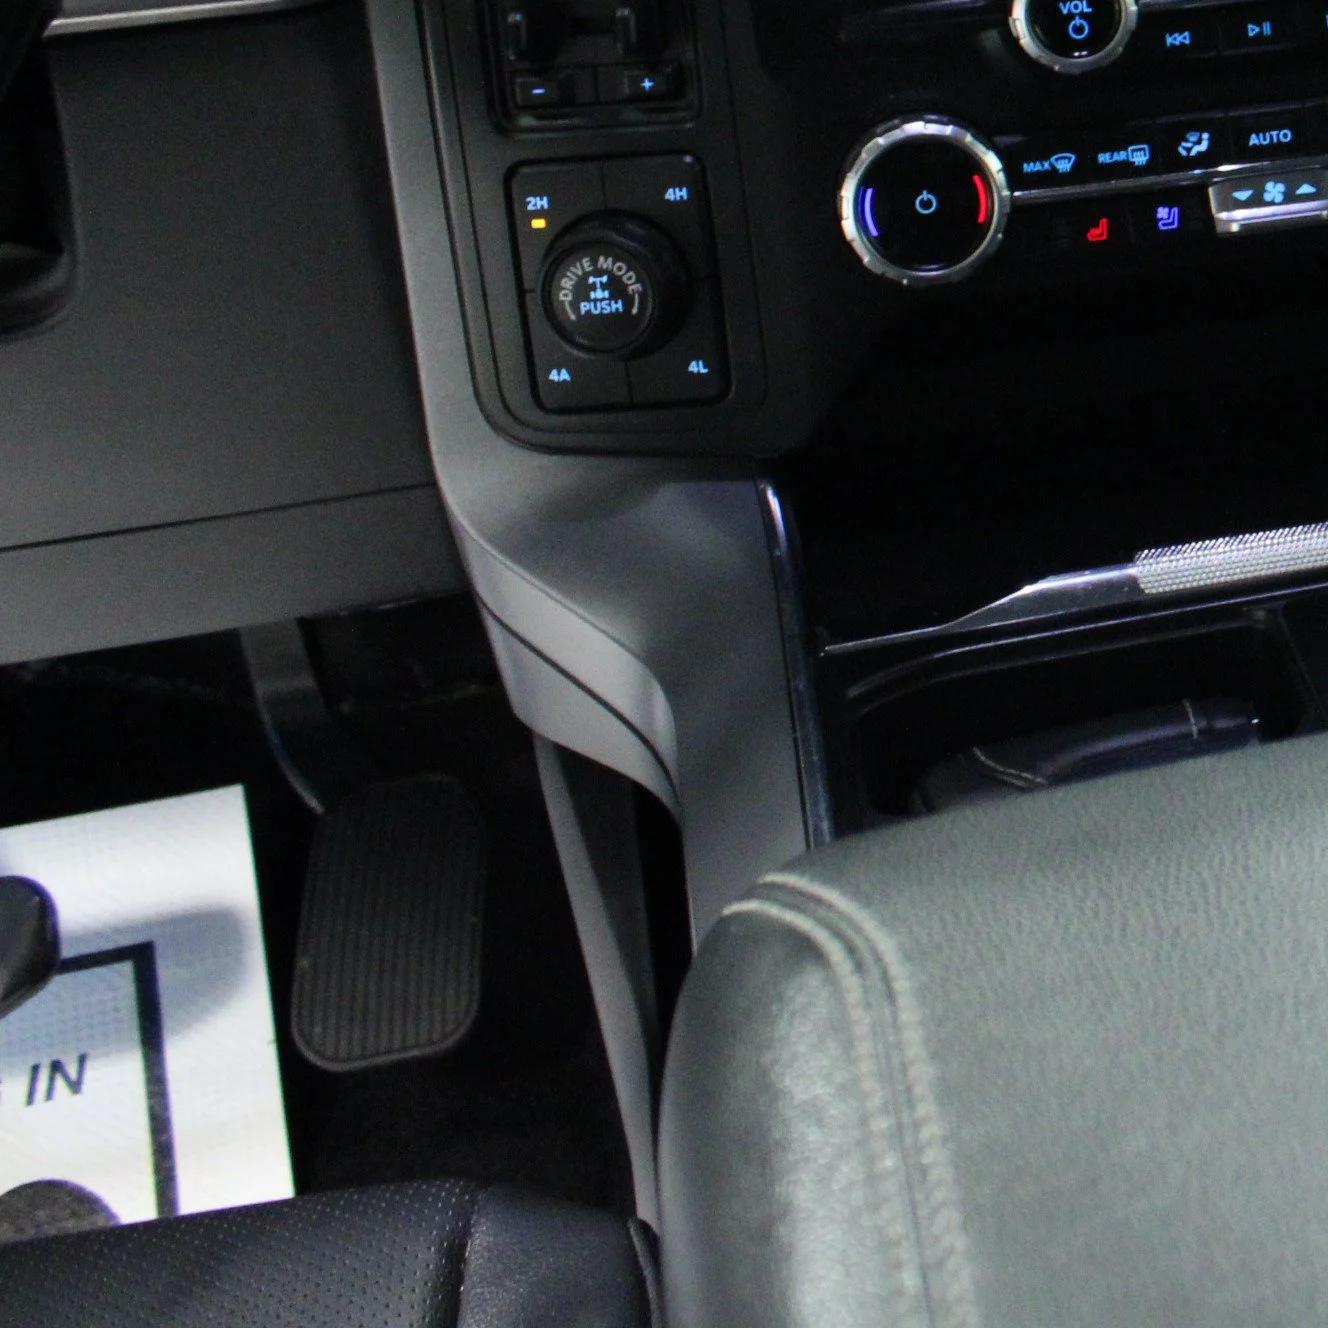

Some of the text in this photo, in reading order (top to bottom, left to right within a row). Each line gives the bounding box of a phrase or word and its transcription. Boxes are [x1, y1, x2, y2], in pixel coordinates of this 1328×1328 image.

[1059, 0, 1093, 16] VOL
[1248, 128, 1292, 147] AUTO
[1097, 150, 1128, 165] REAR
[1023, 159, 1052, 174] MAX
[664, 186, 688, 202] 4H
[525, 195, 549, 211] 2H
[559, 255, 643, 302] DRIVE MODE
[580, 298, 624, 316] PUSH
[688, 359, 709, 375] 4L
[548, 367, 572, 384] 4A
[25, 1052, 88, 1106] IN
